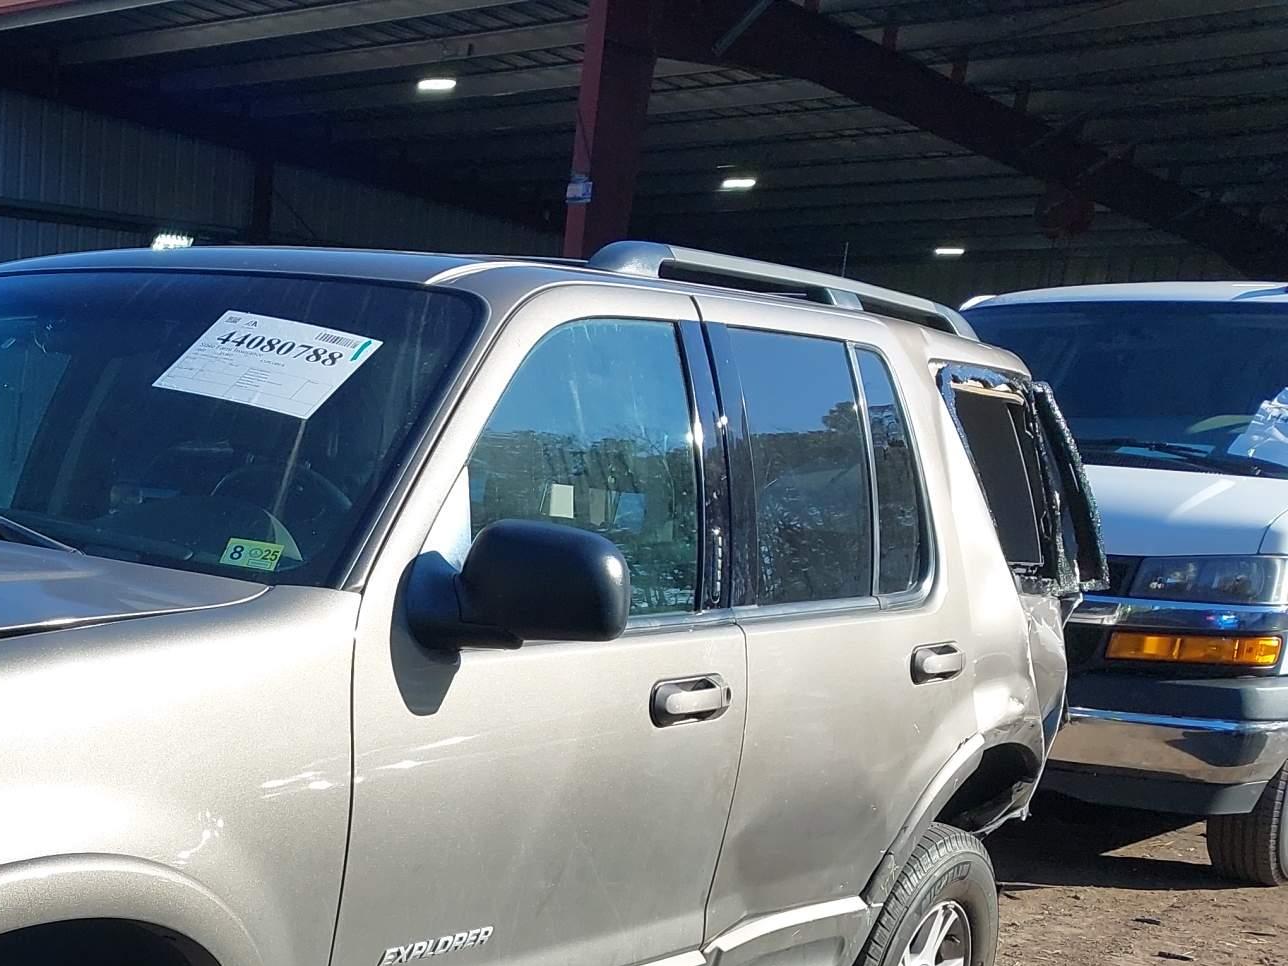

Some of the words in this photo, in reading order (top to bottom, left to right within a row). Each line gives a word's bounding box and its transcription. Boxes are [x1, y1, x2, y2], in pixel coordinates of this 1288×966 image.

[217, 330, 344, 367] 44080788
[230, 545, 244, 560] 8
[261, 549, 280, 561] 25
